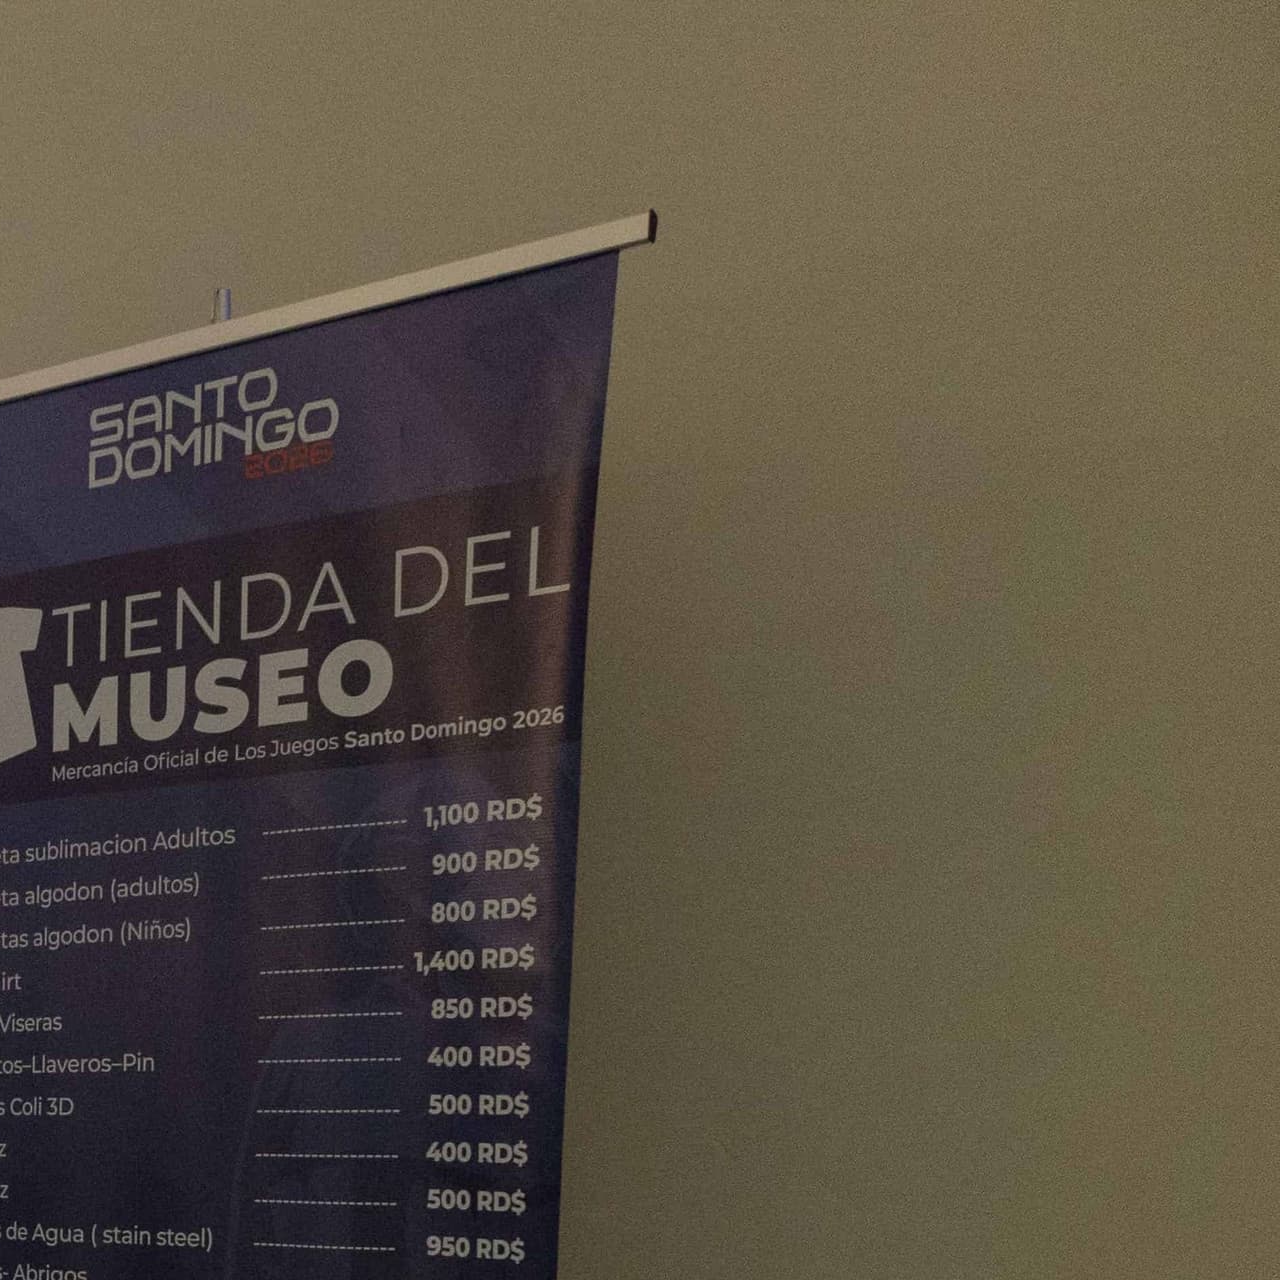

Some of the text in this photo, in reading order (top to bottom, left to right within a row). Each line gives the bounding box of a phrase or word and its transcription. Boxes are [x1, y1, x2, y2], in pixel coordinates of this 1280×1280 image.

[89, 367, 278, 447] SANTO
[89, 398, 339, 489] DOMINGO
[245, 440, 334, 480] 2026
[52, 526, 571, 668] TIENDA DEL
[52, 638, 394, 752] MUSEO
[51, 705, 566, 782] Mercancía Oficial de Los Juegos Santo Domingo 2026
[423, 792, 542, 831] 1,100 RD$
[25, 834, 146, 863] sublimacion
[153, 827, 236, 851] Adultos
[432, 843, 540, 875] 900 RD$
[25, 882, 103, 908] algodon
[110, 872, 199, 903] (adultos)
[431, 893, 537, 924] 800 RD$
[33, 925, 113, 950] algodon
[121, 917, 191, 946] (Niños)
[413, 943, 535, 977] 1,400 RD$
[431, 992, 533, 1021] 850 RD$
[427, 1042, 531, 1069] 400 RD$
[10, 1097, 42, 1116] Coli
[46, 1097, 74, 1116] 3D
[428, 1090, 529, 1119] 500 RD$
[426, 1139, 528, 1167] 400 RD$
[427, 1188, 526, 1216] 500 RD$
[6, 1221, 28, 1241] de
[32, 1223, 84, 1246] Agua
[156, 1227, 213, 1252] steel)
[426, 1236, 525, 1264] 950 RD$
